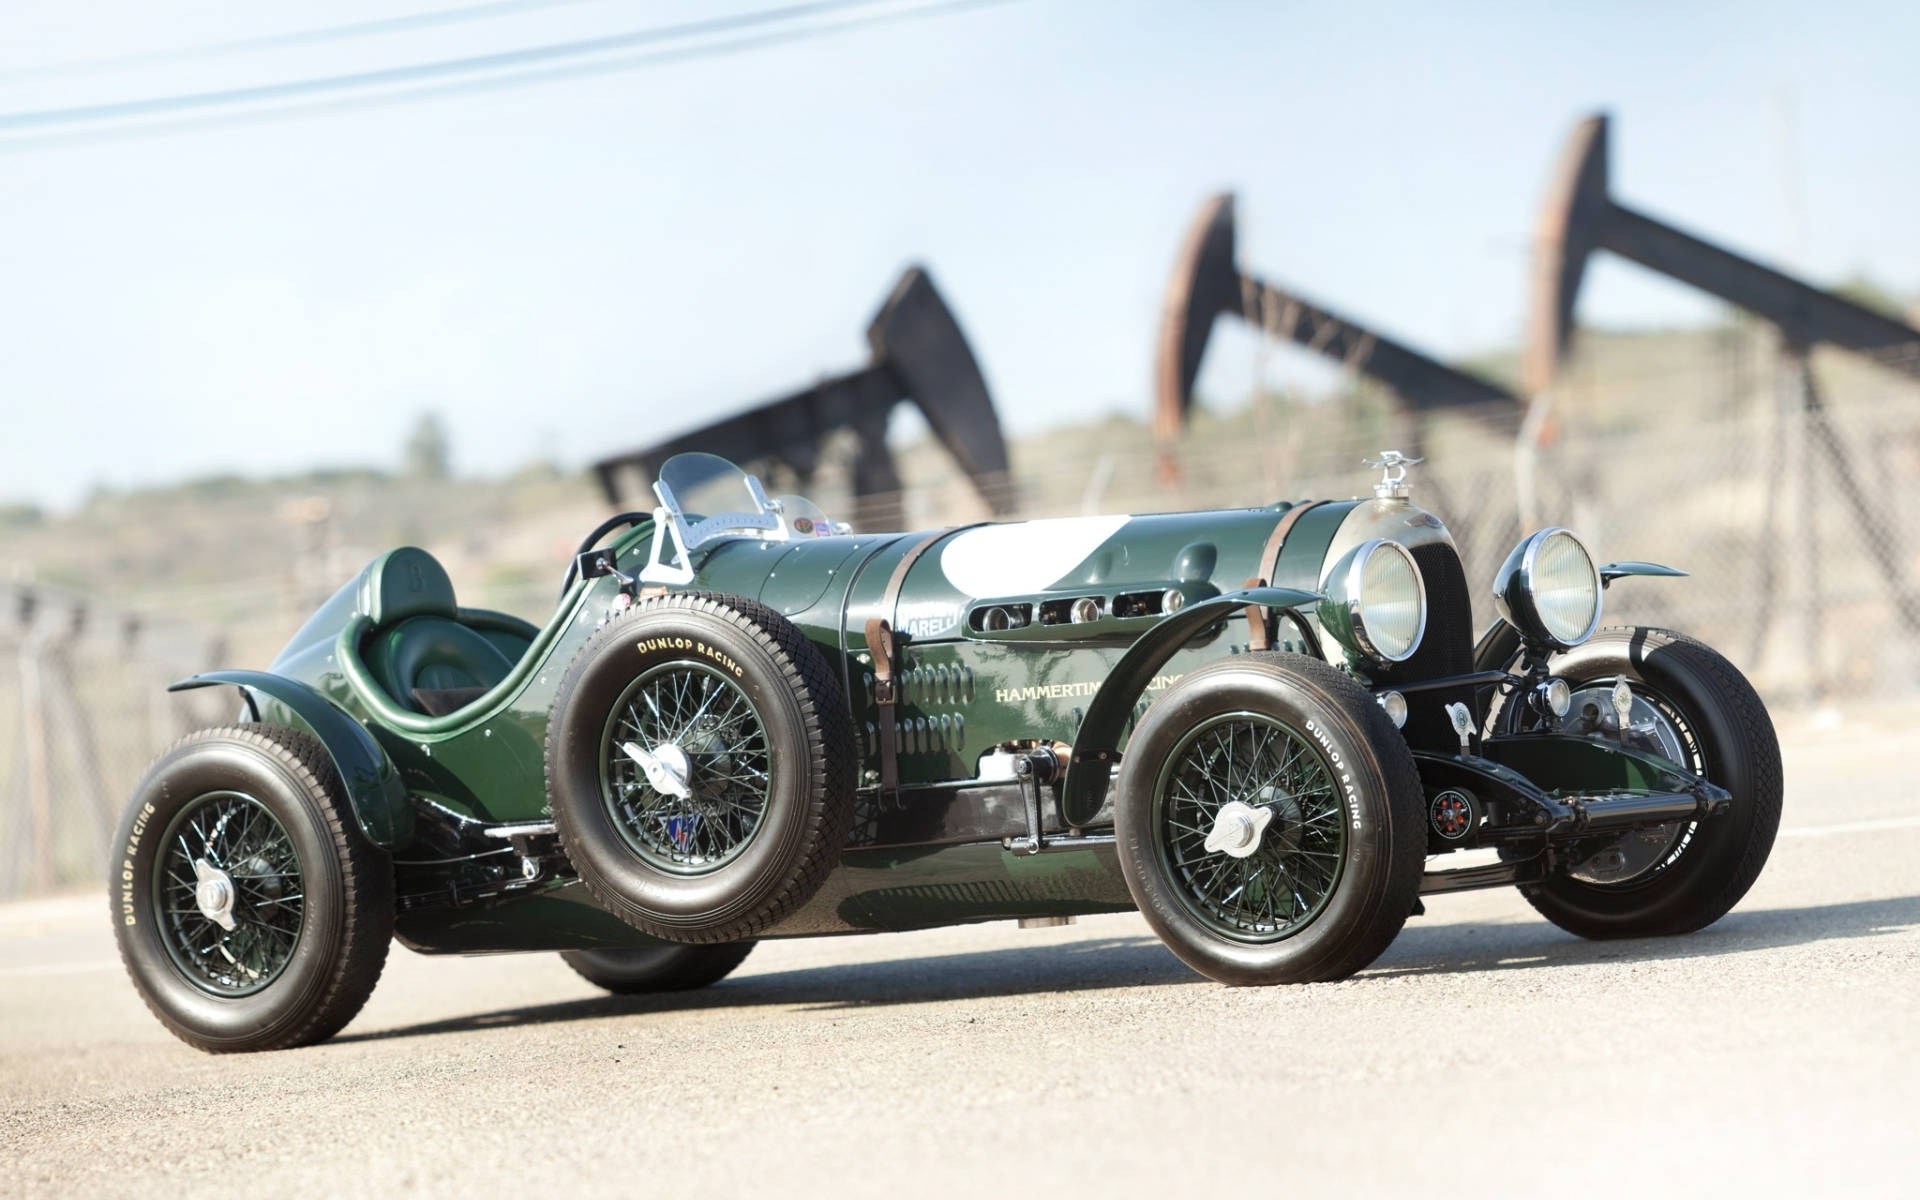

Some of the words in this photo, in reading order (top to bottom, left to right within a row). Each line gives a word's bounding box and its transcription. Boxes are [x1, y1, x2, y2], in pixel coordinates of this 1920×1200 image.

[637, 637, 693, 654] DUNLOP
[697, 642, 744, 678] RACING
[996, 681, 1101, 702] HAMMERTIM
[1305, 720, 1344, 770] DUNLOP
[1341, 774, 1362, 830] RACING
[127, 802, 155, 856] RACING
[122, 860, 136, 926] DUNLOP
